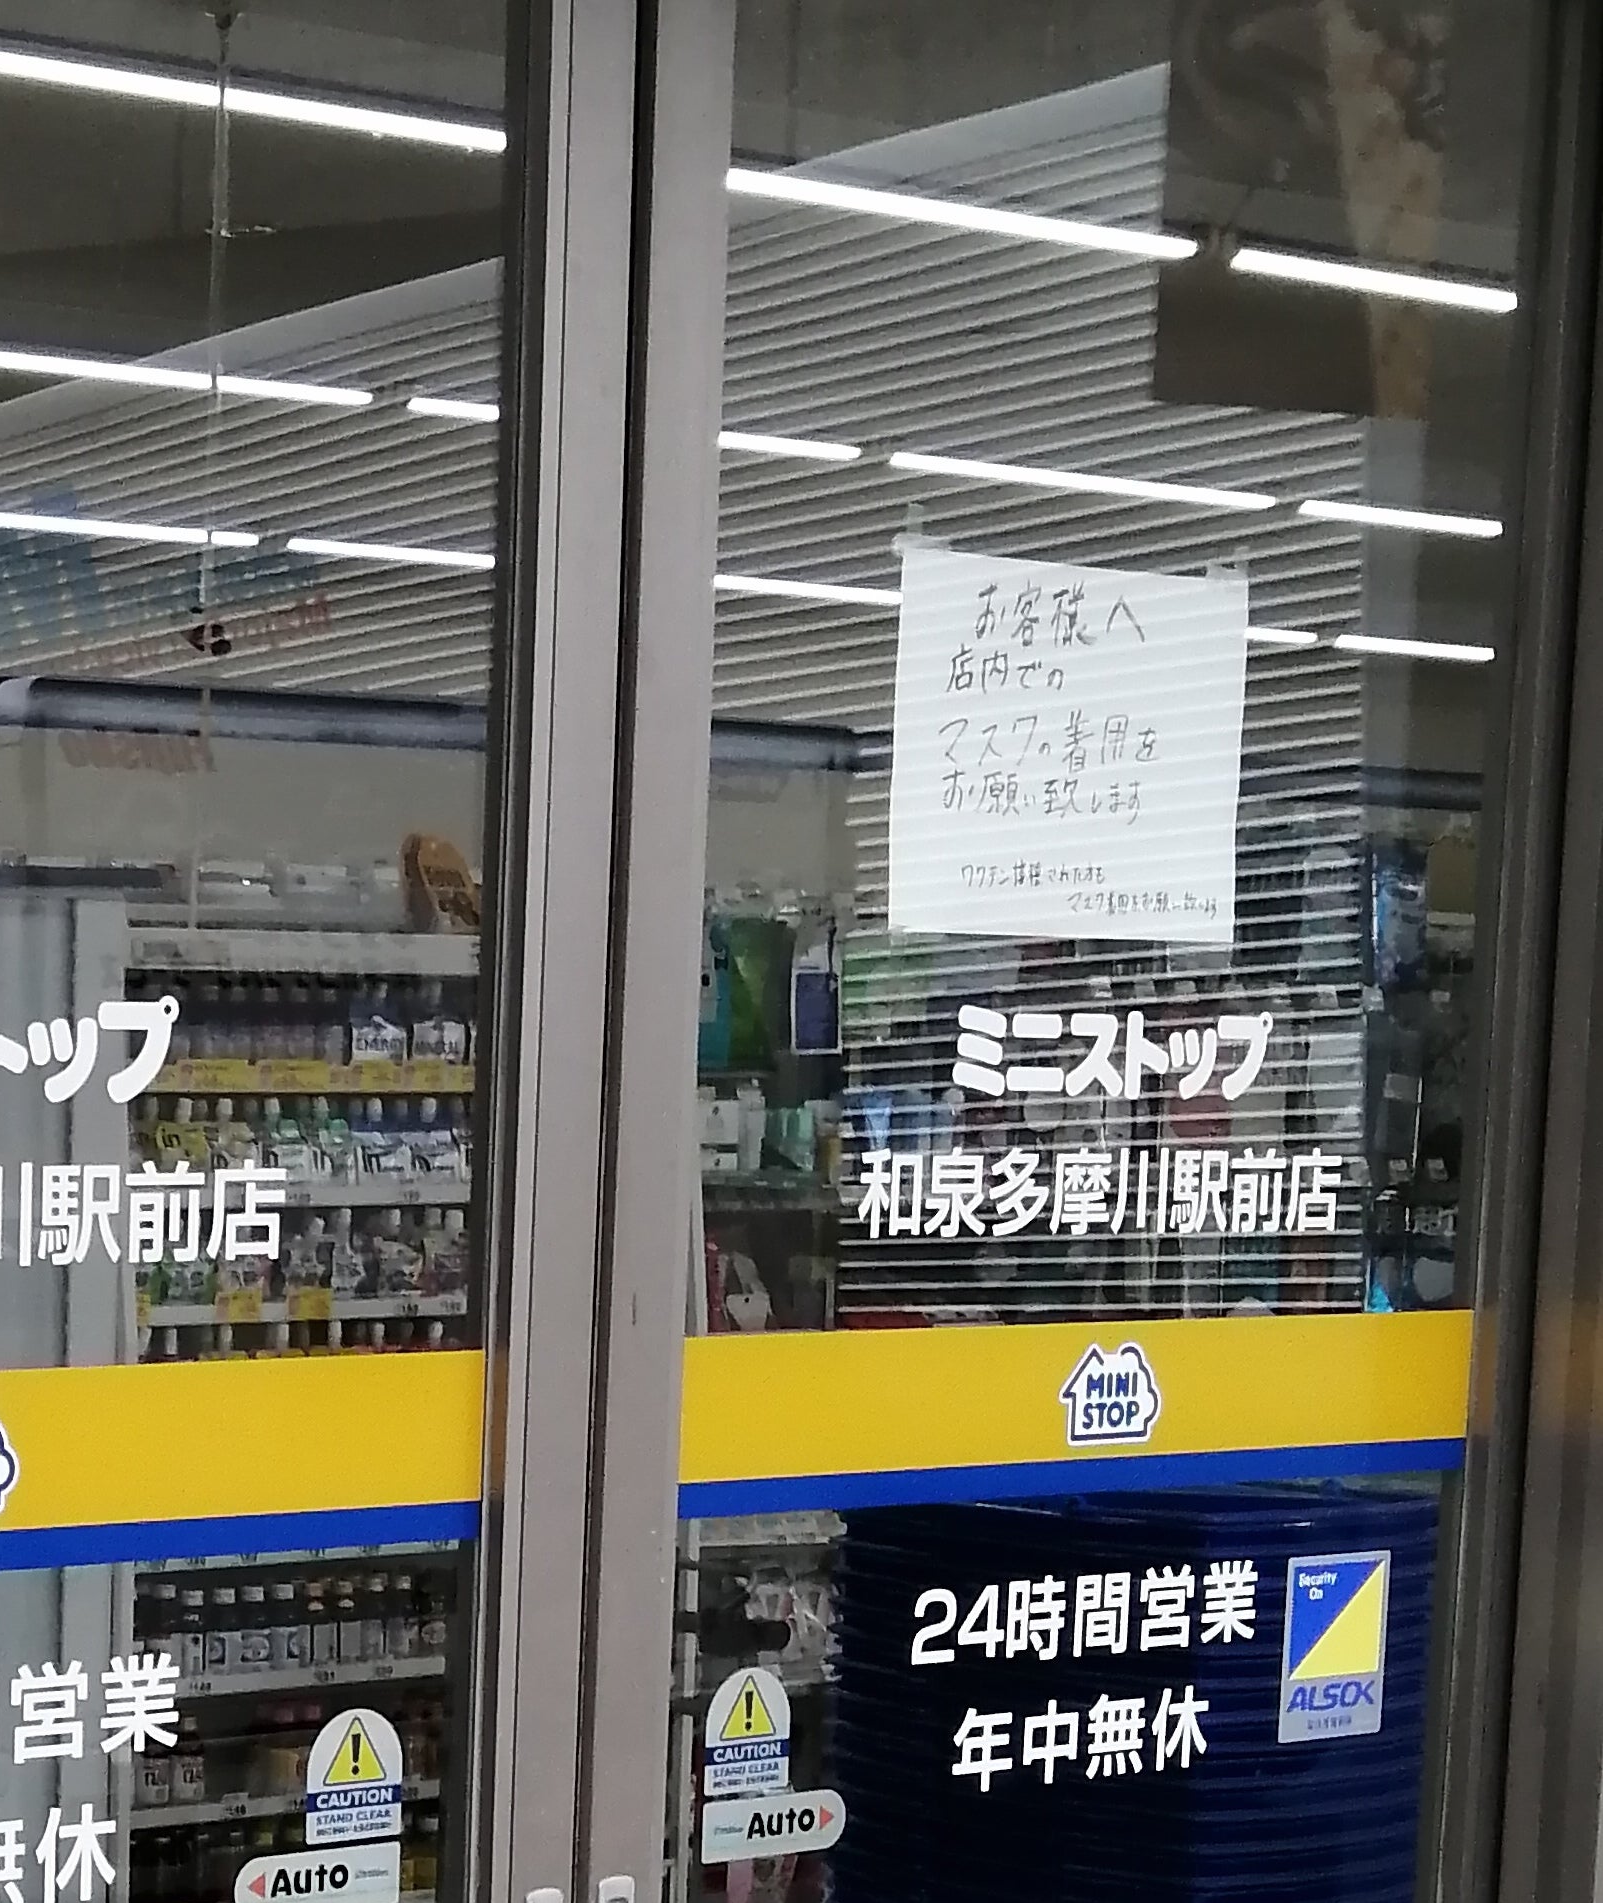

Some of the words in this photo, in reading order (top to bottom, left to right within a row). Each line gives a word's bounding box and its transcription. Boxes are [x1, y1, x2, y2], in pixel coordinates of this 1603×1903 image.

[975, 581, 1145, 647] お客様へ
[946, 643, 1064, 694] 店内での
[938, 709, 1159, 774] マスクの着用を
[942, 769, 1142, 826] お願い致します
[952, 1004, 1272, 1102] ミニストップ
[857, 1147, 1342, 1239] 和泉多摩川駅前店
[1084, 1369, 1140, 1400] MINI
[1081, 1399, 1141, 1432] STOP
[910, 1559, 1260, 1666] 24時間営業
[1286, 1681, 1375, 1713] ALSOK
[713, 1742, 782, 1763] CAUTION
[951, 1685, 1209, 1793] 年中無休
[316, 1788, 394, 1809] CAUTION
[747, 1808, 816, 1840] Auto
[271, 1864, 349, 1898] Auto
